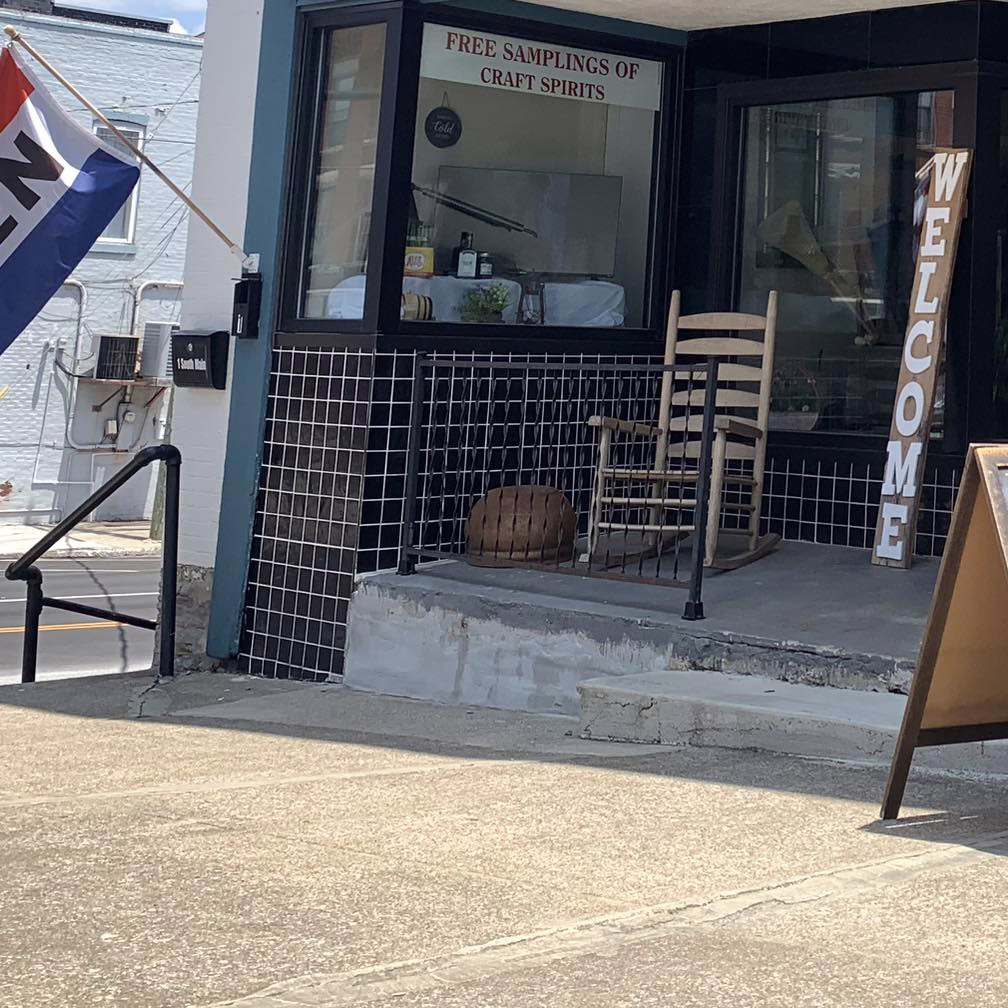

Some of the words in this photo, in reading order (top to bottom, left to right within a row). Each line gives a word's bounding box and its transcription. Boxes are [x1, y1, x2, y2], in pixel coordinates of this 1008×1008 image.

[445, 31, 497, 58] FREE
[503, 42, 609, 76] SAMPLINGS
[616, 61, 640, 80] OF
[481, 67, 536, 91] CRAFT
[541, 77, 606, 101] SPIRITS
[876, 152, 969, 560] WELCOME
